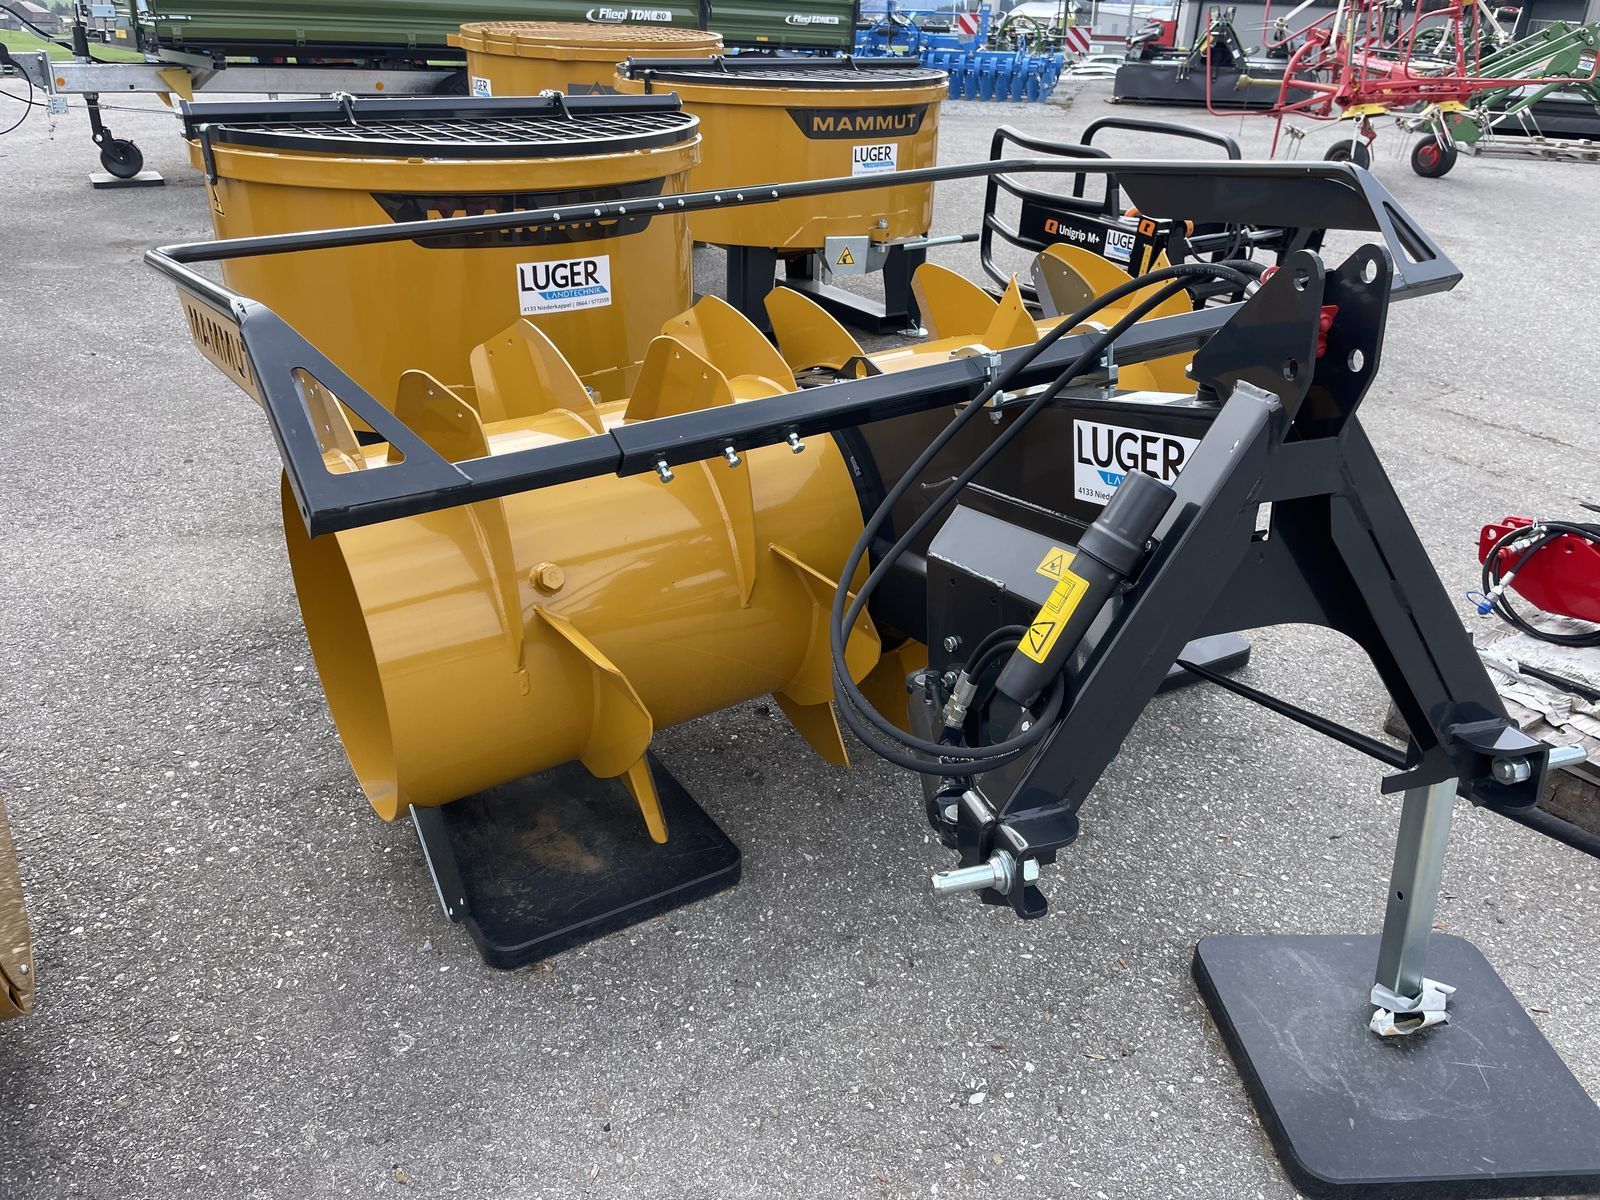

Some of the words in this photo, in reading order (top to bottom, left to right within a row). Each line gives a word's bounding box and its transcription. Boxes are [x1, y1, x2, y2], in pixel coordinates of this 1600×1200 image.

[599, 8, 628, 20] Fliegl
[631, 9, 651, 21] TDK
[656, 12, 667, 20] 80
[813, 113, 916, 132] MAMMUT
[854, 146, 892, 163] LUGER
[1059, 224, 1086, 242] Unigrip
[1087, 232, 1100, 244] M+
[1107, 231, 1134, 250] LUGE
[520, 260, 600, 292] LUGER
[546, 285, 601, 299] LANDTECHNIK
[537, 302, 572, 311] Niederkappel
[1077, 424, 1185, 481] LUGER
[1107, 473, 1124, 485] LA
[1078, 487, 1094, 497] 4133
